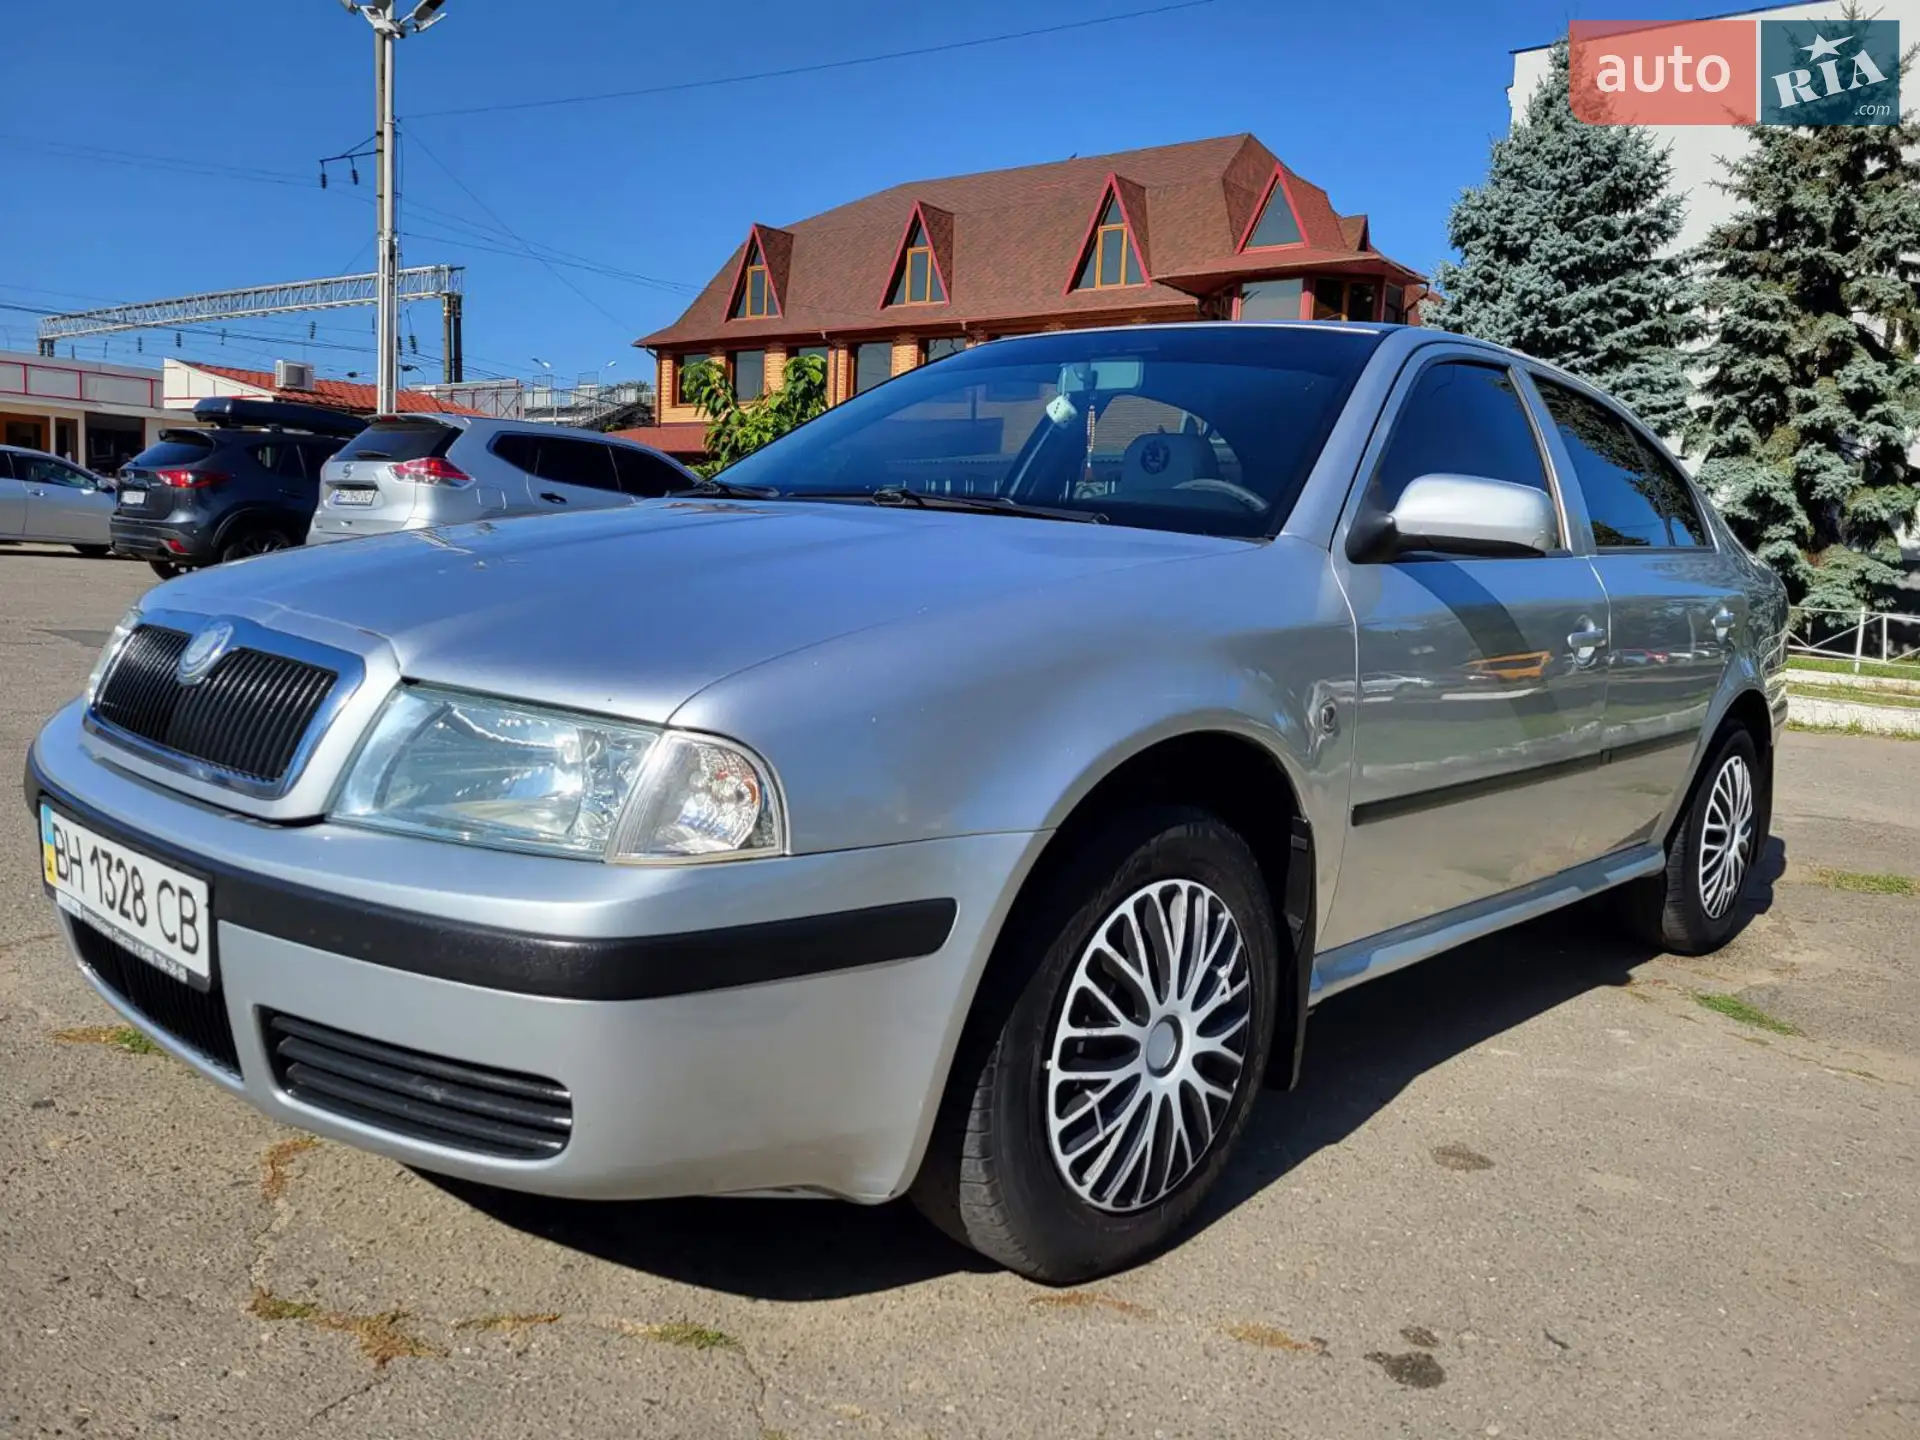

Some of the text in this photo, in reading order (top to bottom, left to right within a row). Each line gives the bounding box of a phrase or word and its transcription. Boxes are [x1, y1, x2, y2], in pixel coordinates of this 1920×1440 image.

[54, 823, 85, 893] BH
[90, 845, 147, 928] 1328
[158, 879, 199, 955] CB
